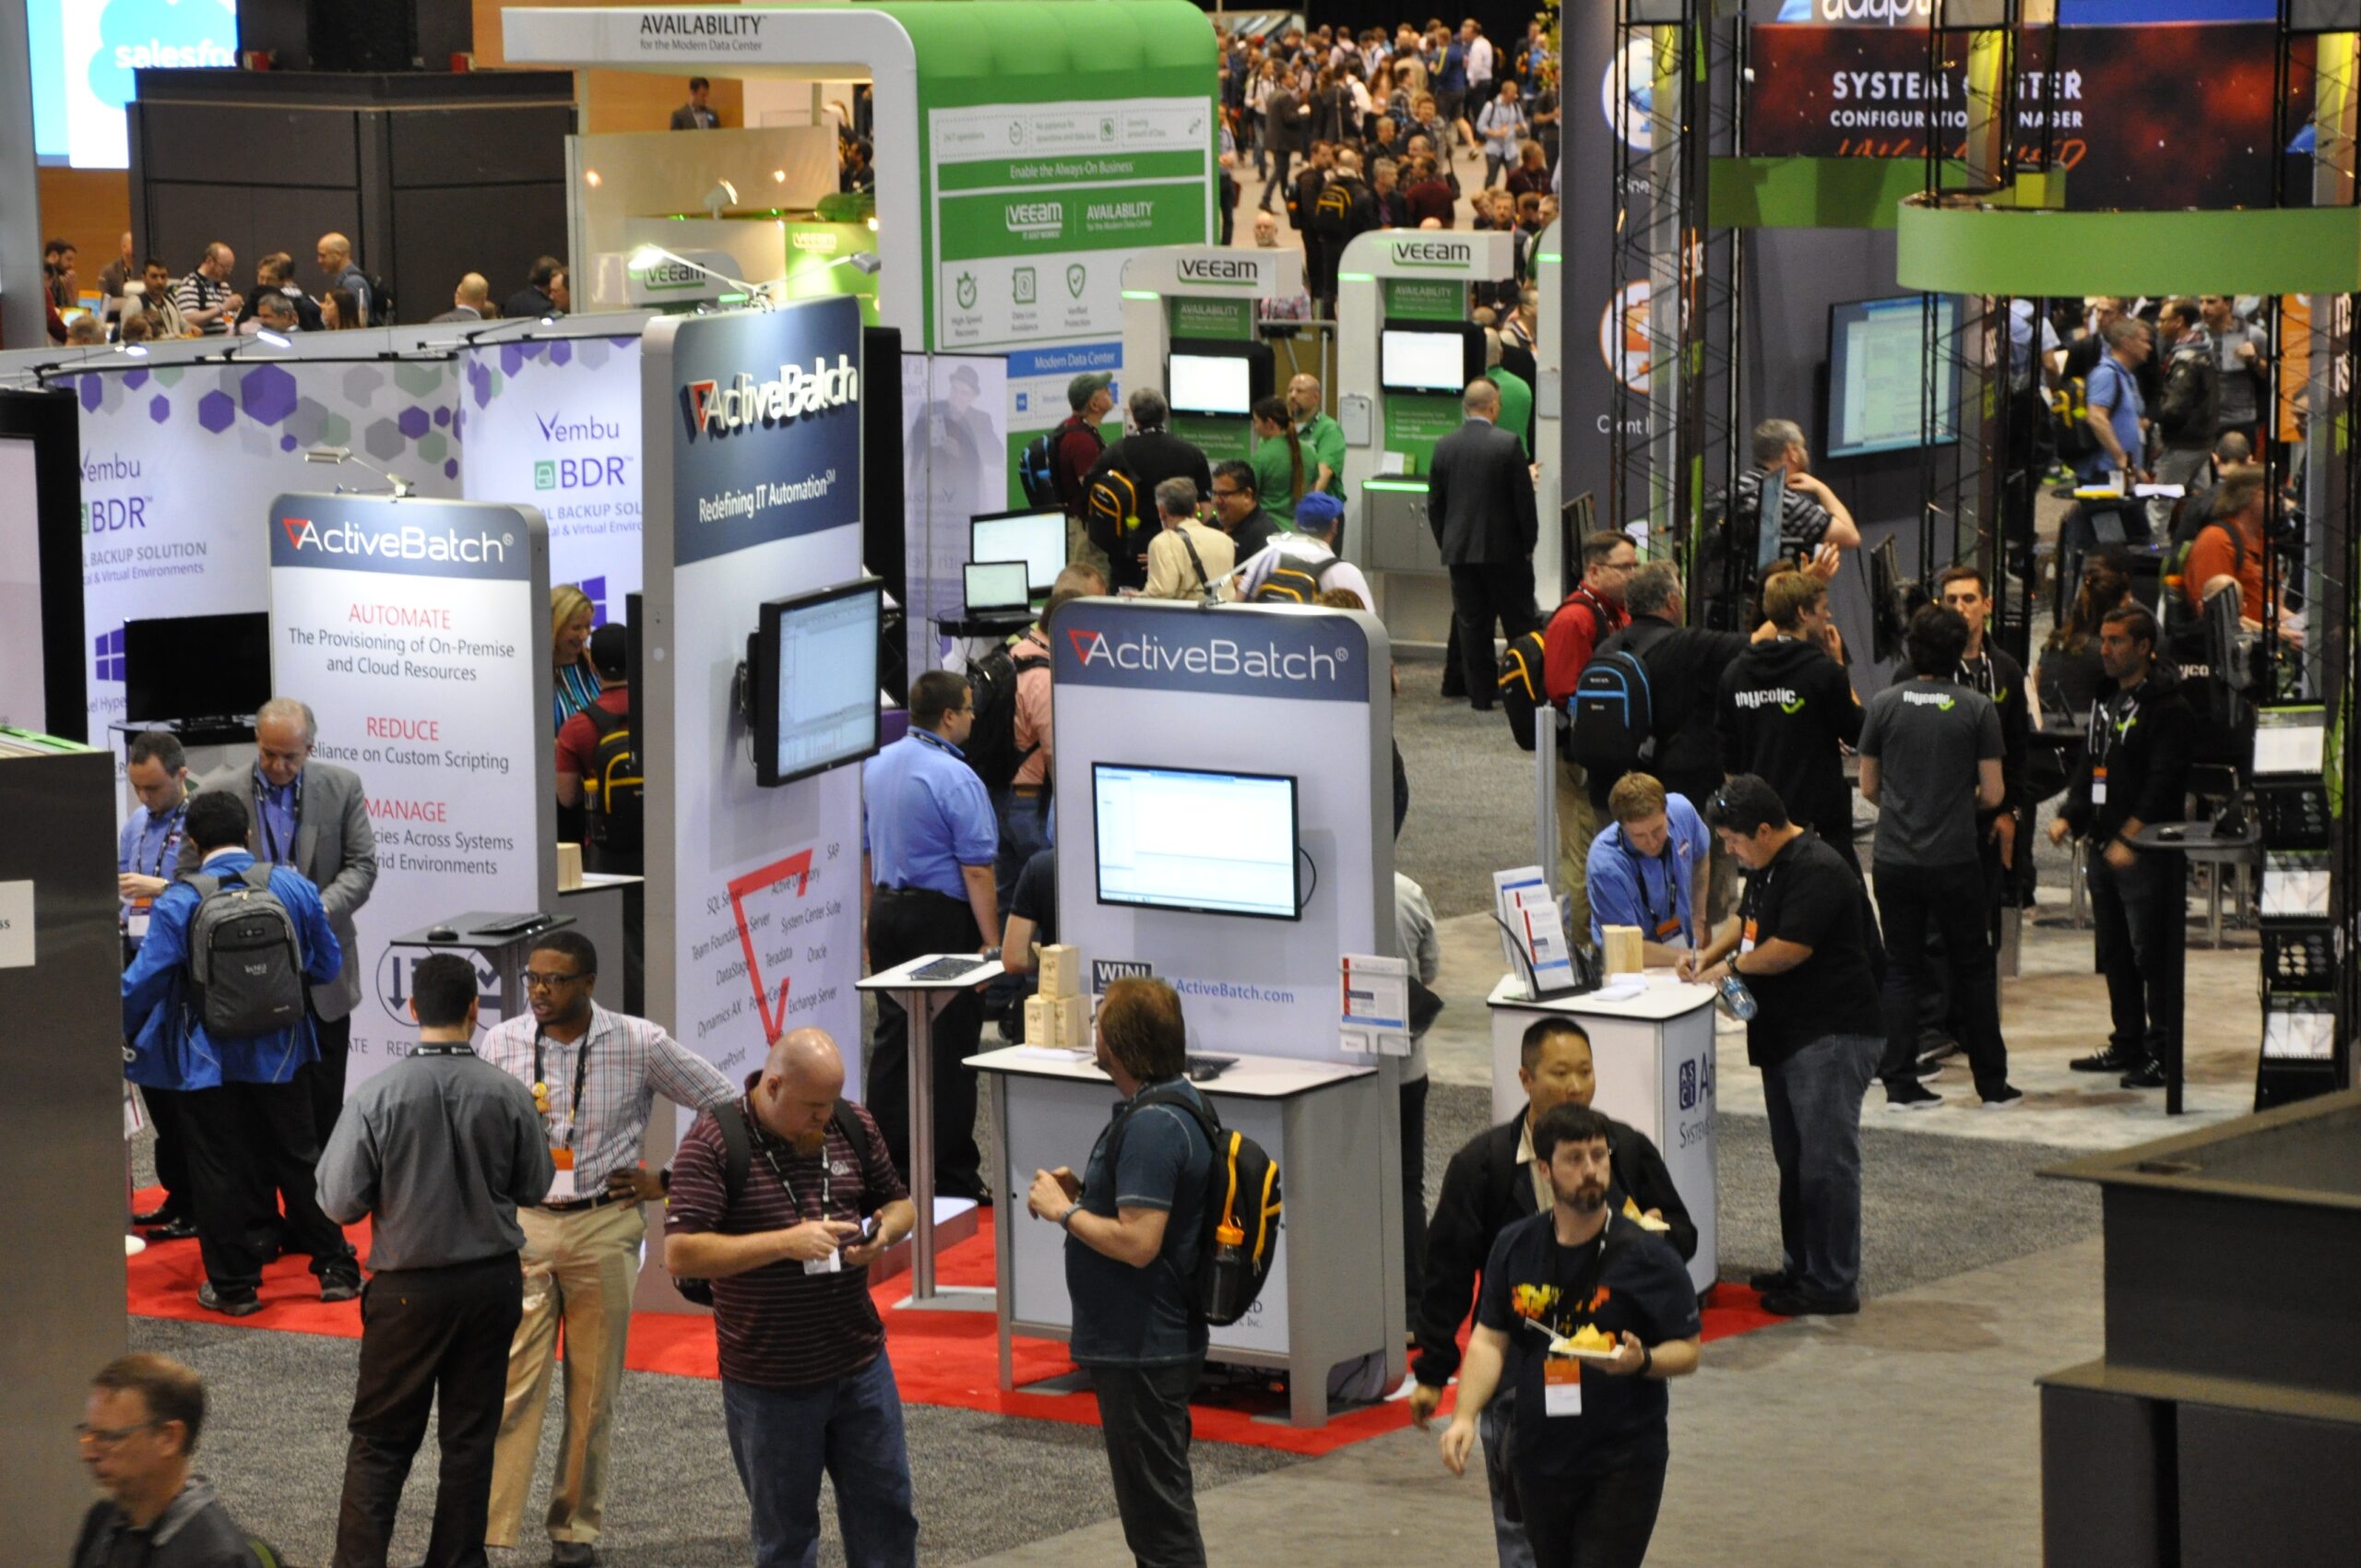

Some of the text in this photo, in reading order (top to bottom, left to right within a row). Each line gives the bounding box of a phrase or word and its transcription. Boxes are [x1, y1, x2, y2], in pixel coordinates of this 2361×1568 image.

[640, 15, 762, 35] AVAILABILITY
[640, 39, 762, 52] for the Modern Data Center
[1010, 164, 1039, 179] Enable
[1040, 163, 1053, 178] the
[1099, 160, 1134, 175] Business
[1086, 201, 1153, 221] AVAILABILITY
[1035, 351, 1115, 369] Modern Data Center
[535, 409, 620, 443] Vembu
[557, 503, 611, 520] BACKUP
[698, 489, 754, 524] Redefining
[756, 483, 766, 510] IT
[573, 521, 606, 535] Virtual
[90, 547, 134, 567] BACKUP
[136, 541, 208, 562] SOLUTION
[102, 568, 129, 583] Virtual
[132, 563, 206, 580] Environments
[349, 603, 452, 630] AUTOMATE
[289, 627, 516, 658] The Provisioning of On-Premise
[326, 656, 477, 681] and Cloud Resources
[366, 717, 439, 742] REDUCE
[362, 748, 381, 764] on
[385, 746, 441, 766] Custom
[445, 751, 509, 774] Scripting
[363, 797, 447, 823] MANAGE
[404, 829, 451, 849] Across
[455, 832, 514, 853] Systems
[399, 853, 498, 875] Environments
[781, 899, 842, 937] System Center Suite
[692, 943, 710, 963] Team
[749, 911, 771, 932] Server
[765, 945, 793, 968] Teradata
[807, 944, 827, 963] Oracle
[788, 986, 837, 1015] Exchange Server
[1176, 979, 1295, 1004] ActiveBatch.com
[697, 998, 742, 1039] Dynamics AX
